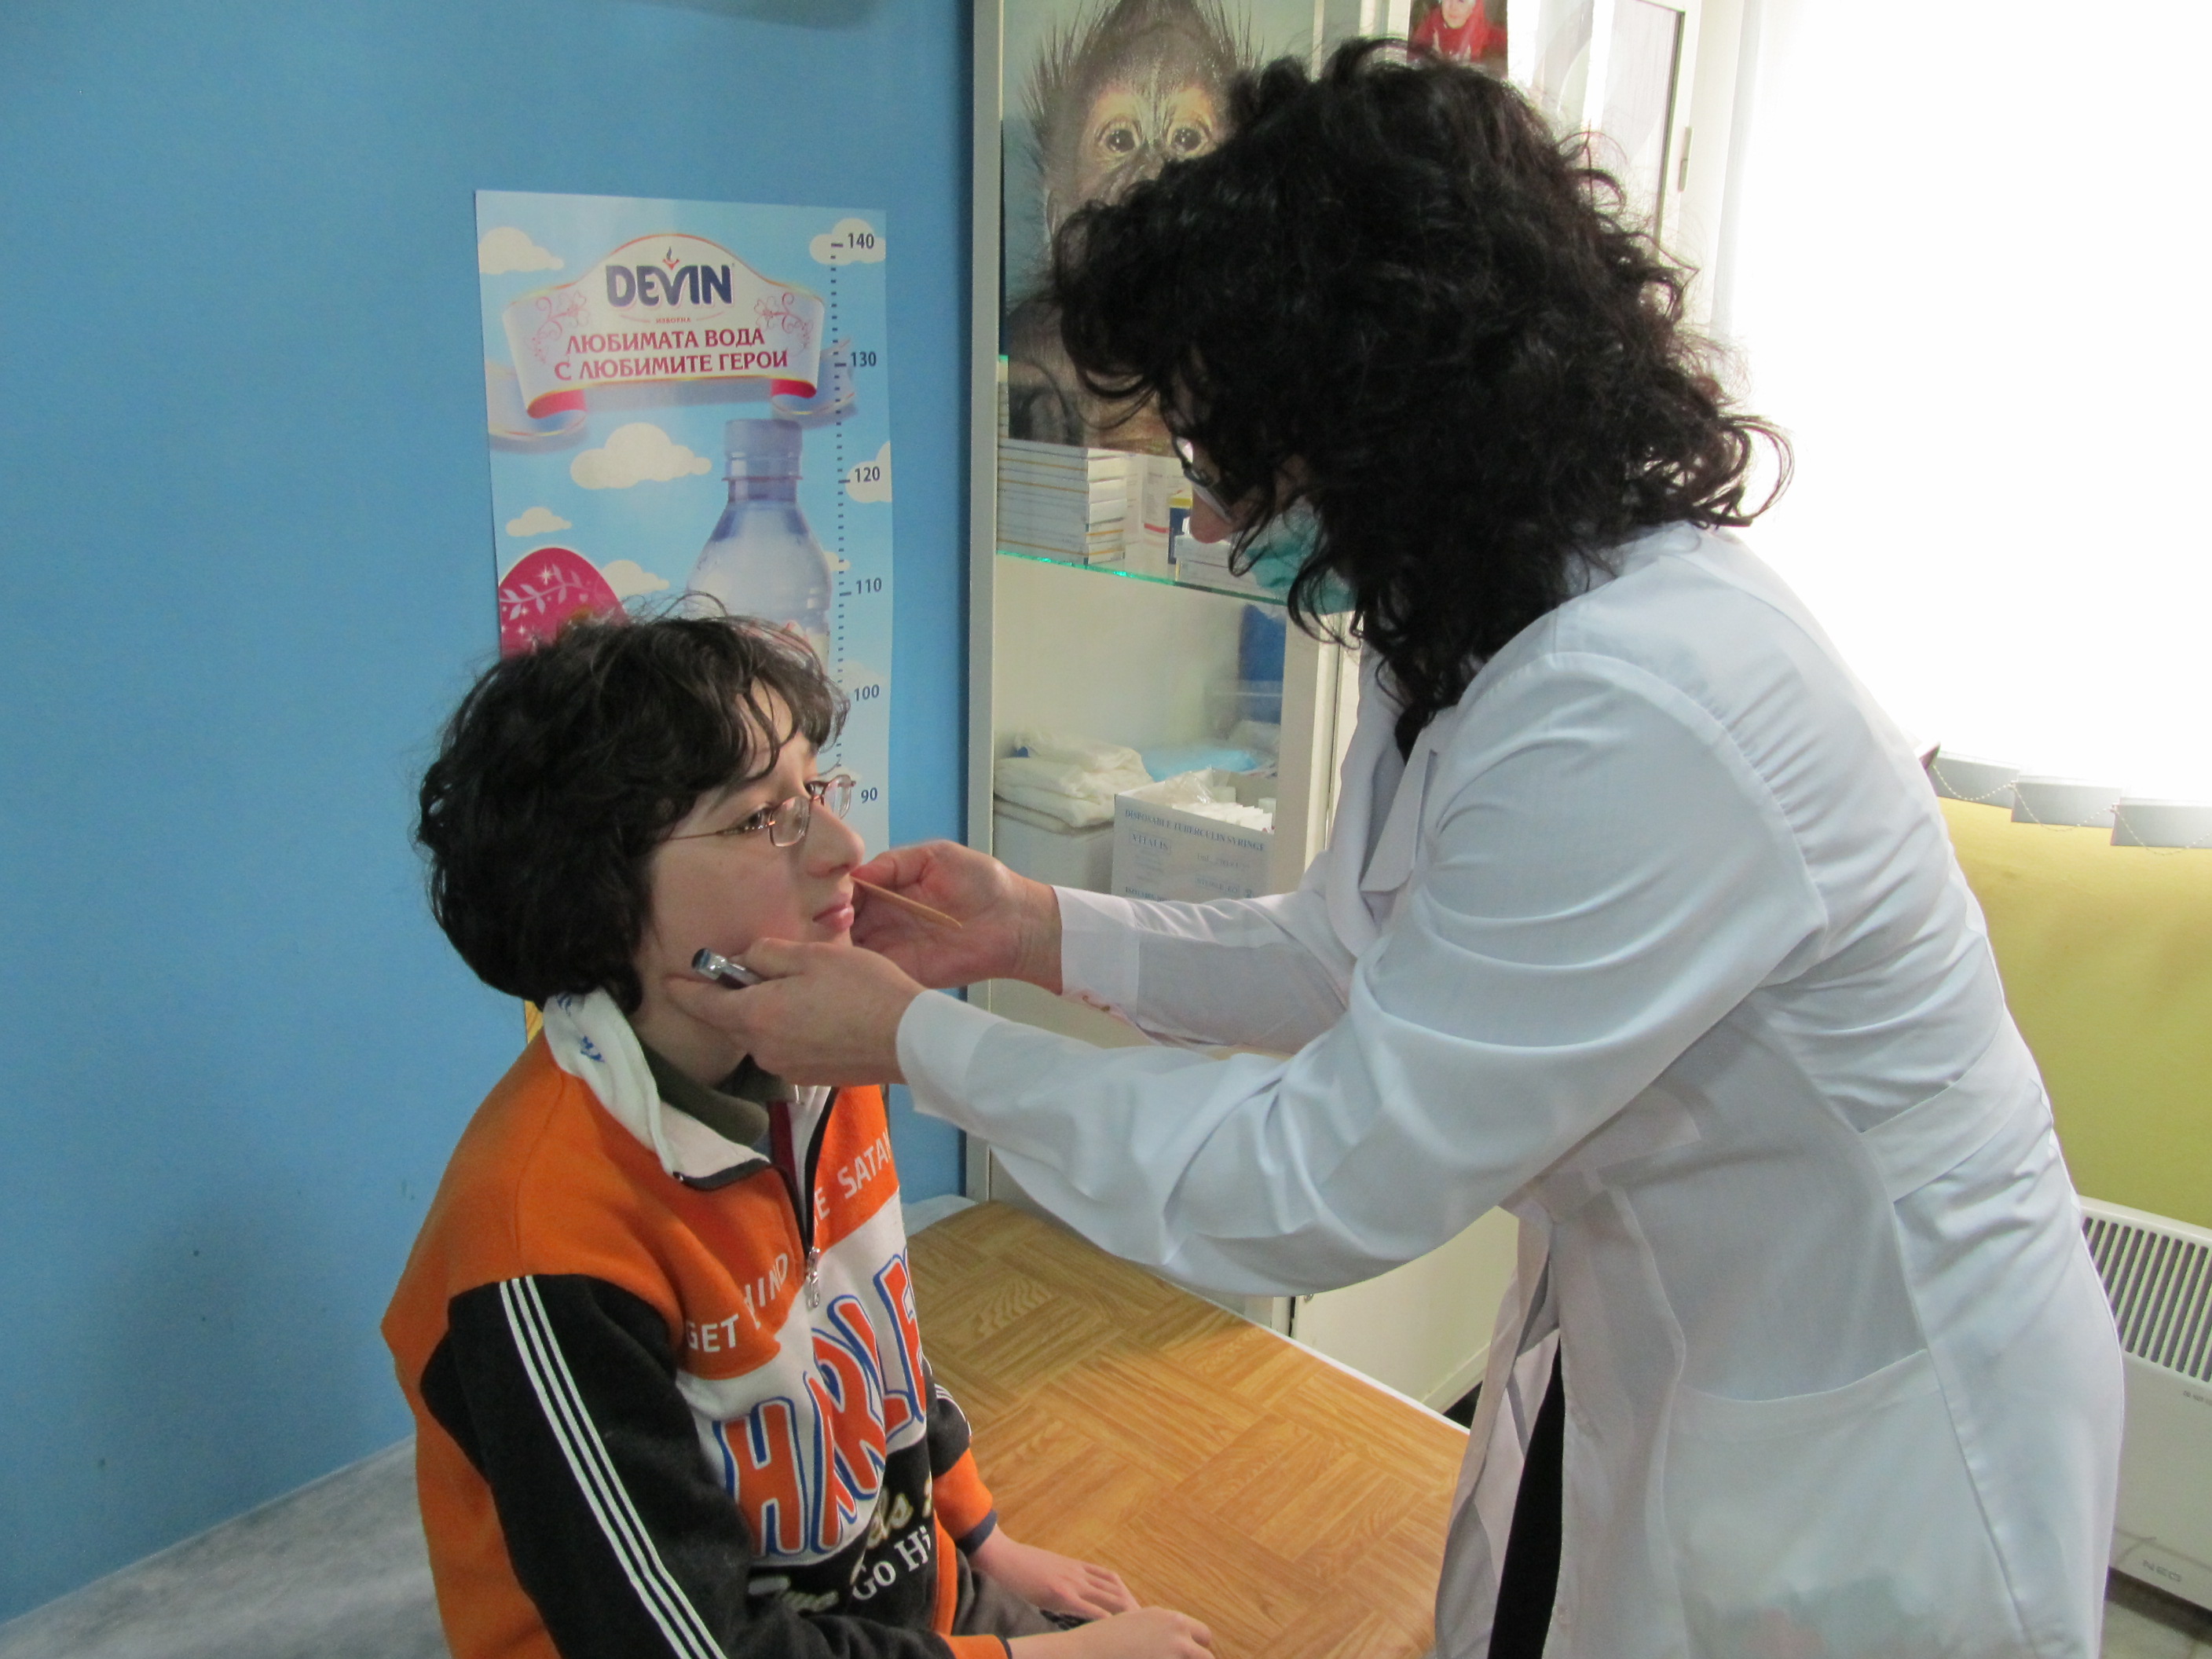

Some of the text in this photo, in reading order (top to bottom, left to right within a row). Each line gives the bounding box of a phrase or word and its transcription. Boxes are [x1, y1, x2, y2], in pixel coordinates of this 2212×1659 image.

[848, 233, 875, 249] 140
[606, 265, 733, 307] DEVIN
[566, 328, 765, 354] ЛЮБИМАТА ВОДА
[555, 350, 789, 381] С ЛЮБИМИТЕ ГЕРОИ
[851, 351, 877, 367] 130
[854, 466, 881, 482] 120
[855, 577, 882, 594] 110
[854, 683, 880, 701] 100
[861, 787, 878, 804] 90
[1227, 836, 1265, 851] SYRINGE
[686, 1313, 739, 1353] GET
